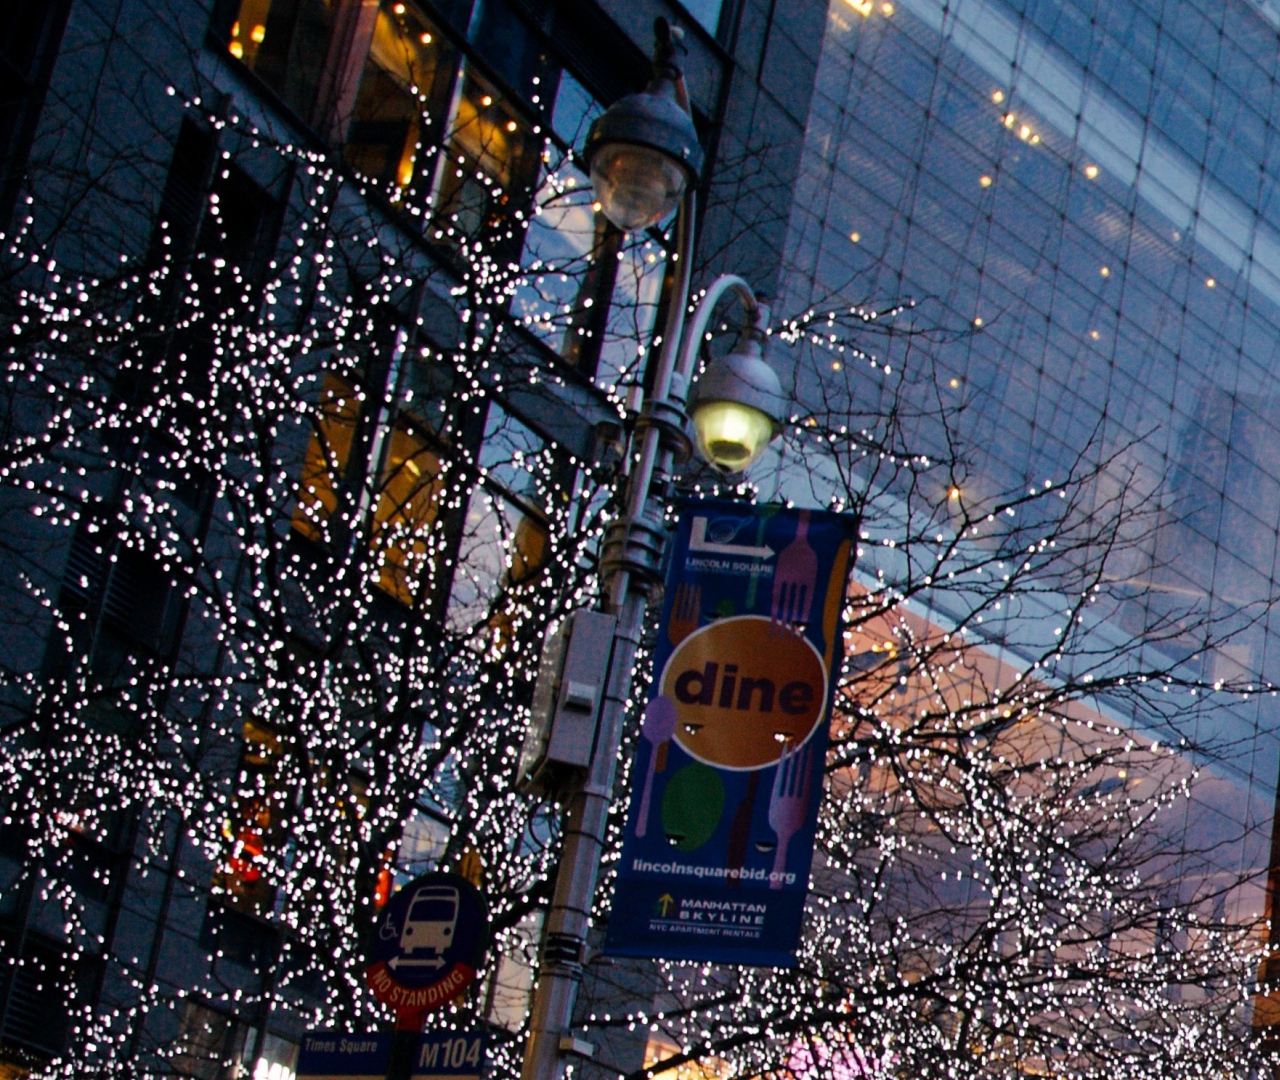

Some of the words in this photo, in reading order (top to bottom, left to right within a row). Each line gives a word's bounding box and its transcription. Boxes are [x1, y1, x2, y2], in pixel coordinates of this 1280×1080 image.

[686, 557, 730, 570] LINCOLN
[731, 561, 775, 574] SQUARE
[674, 661, 814, 716] dine
[632, 858, 797, 885] lincolnsquarebid.org
[680, 899, 767, 913] MANHATTAN
[679, 911, 765, 925] SKYLINE
[669, 925, 720, 936] APARTMENT
[372, 969, 392, 994] NO
[389, 969, 465, 1007] STANDING
[305, 1038, 336, 1052] Times
[340, 1038, 378, 1055] Square
[418, 1037, 482, 1069] M104
